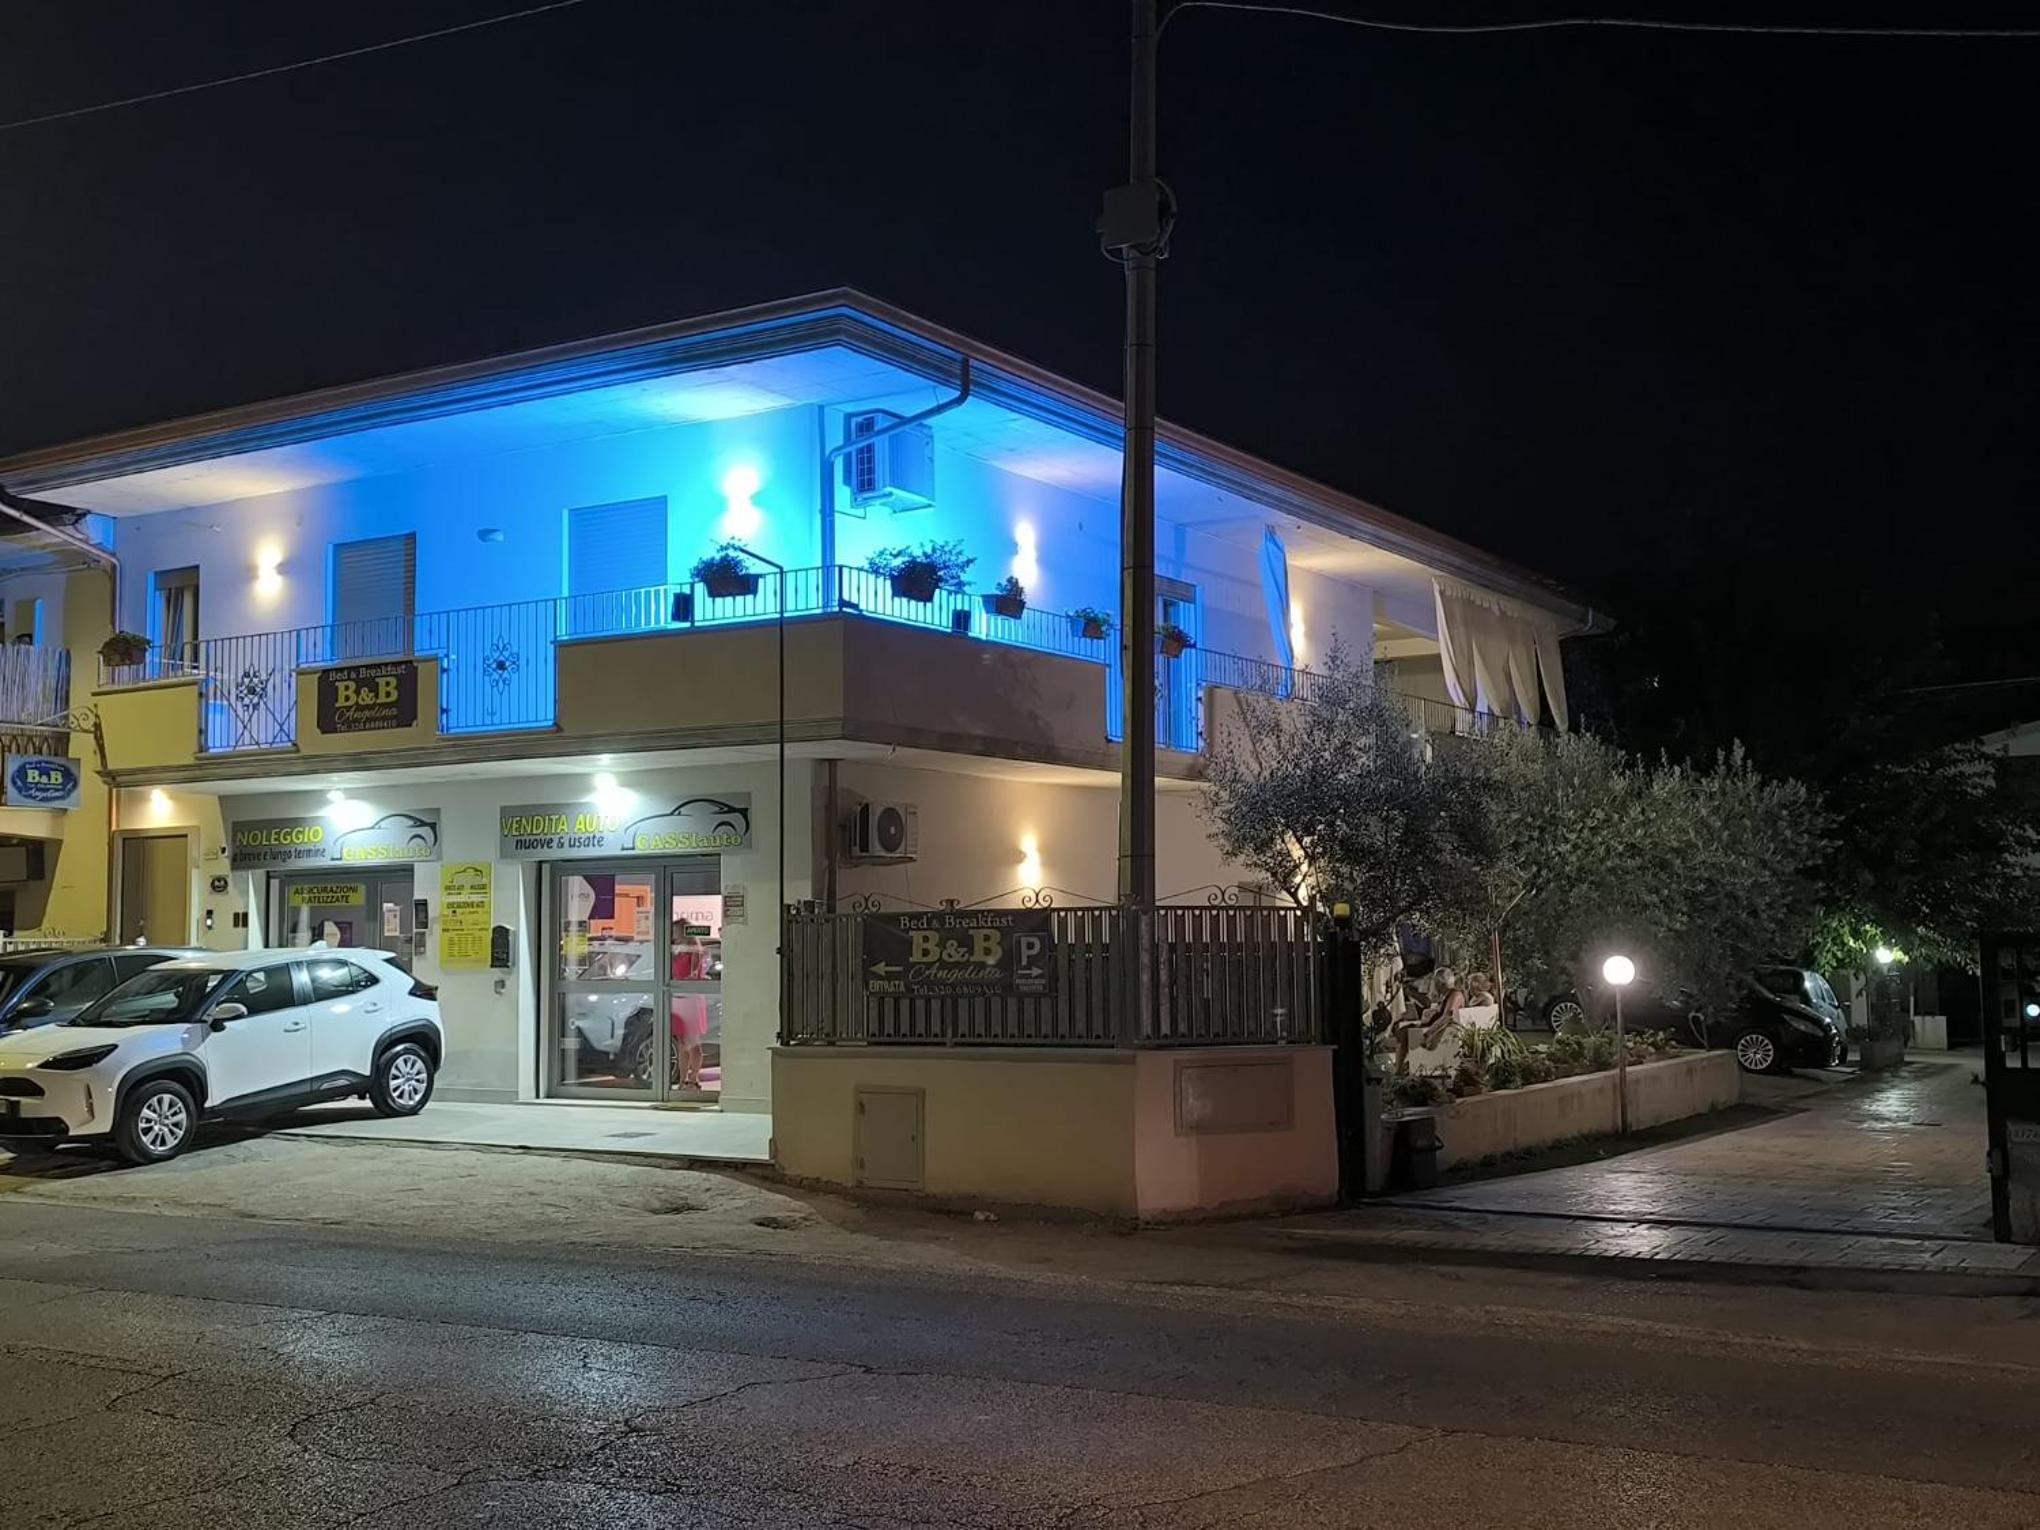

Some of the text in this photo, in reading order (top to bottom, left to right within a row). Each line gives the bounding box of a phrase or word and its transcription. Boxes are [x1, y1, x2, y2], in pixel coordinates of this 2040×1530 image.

[360, 665, 406, 678] Breakfast
[335, 676, 398, 707] B&B
[335, 705, 398, 723] Angelina
[27, 769, 63, 784] B&B
[502, 814, 619, 836] VENDITA AUTO
[236, 825, 324, 846] NOLEGGIO
[514, 835, 605, 850] nuove & usate
[269, 848, 292, 862] lungo
[293, 845, 325, 859] termine
[900, 916, 927, 929] Bed
[944, 914, 1014, 929] Breakfast
[909, 928, 1003, 963] B&B
[1020, 936, 1041, 966] P
[908, 962, 1004, 983] Angelina
[869, 980, 906, 993] ENTRATA
